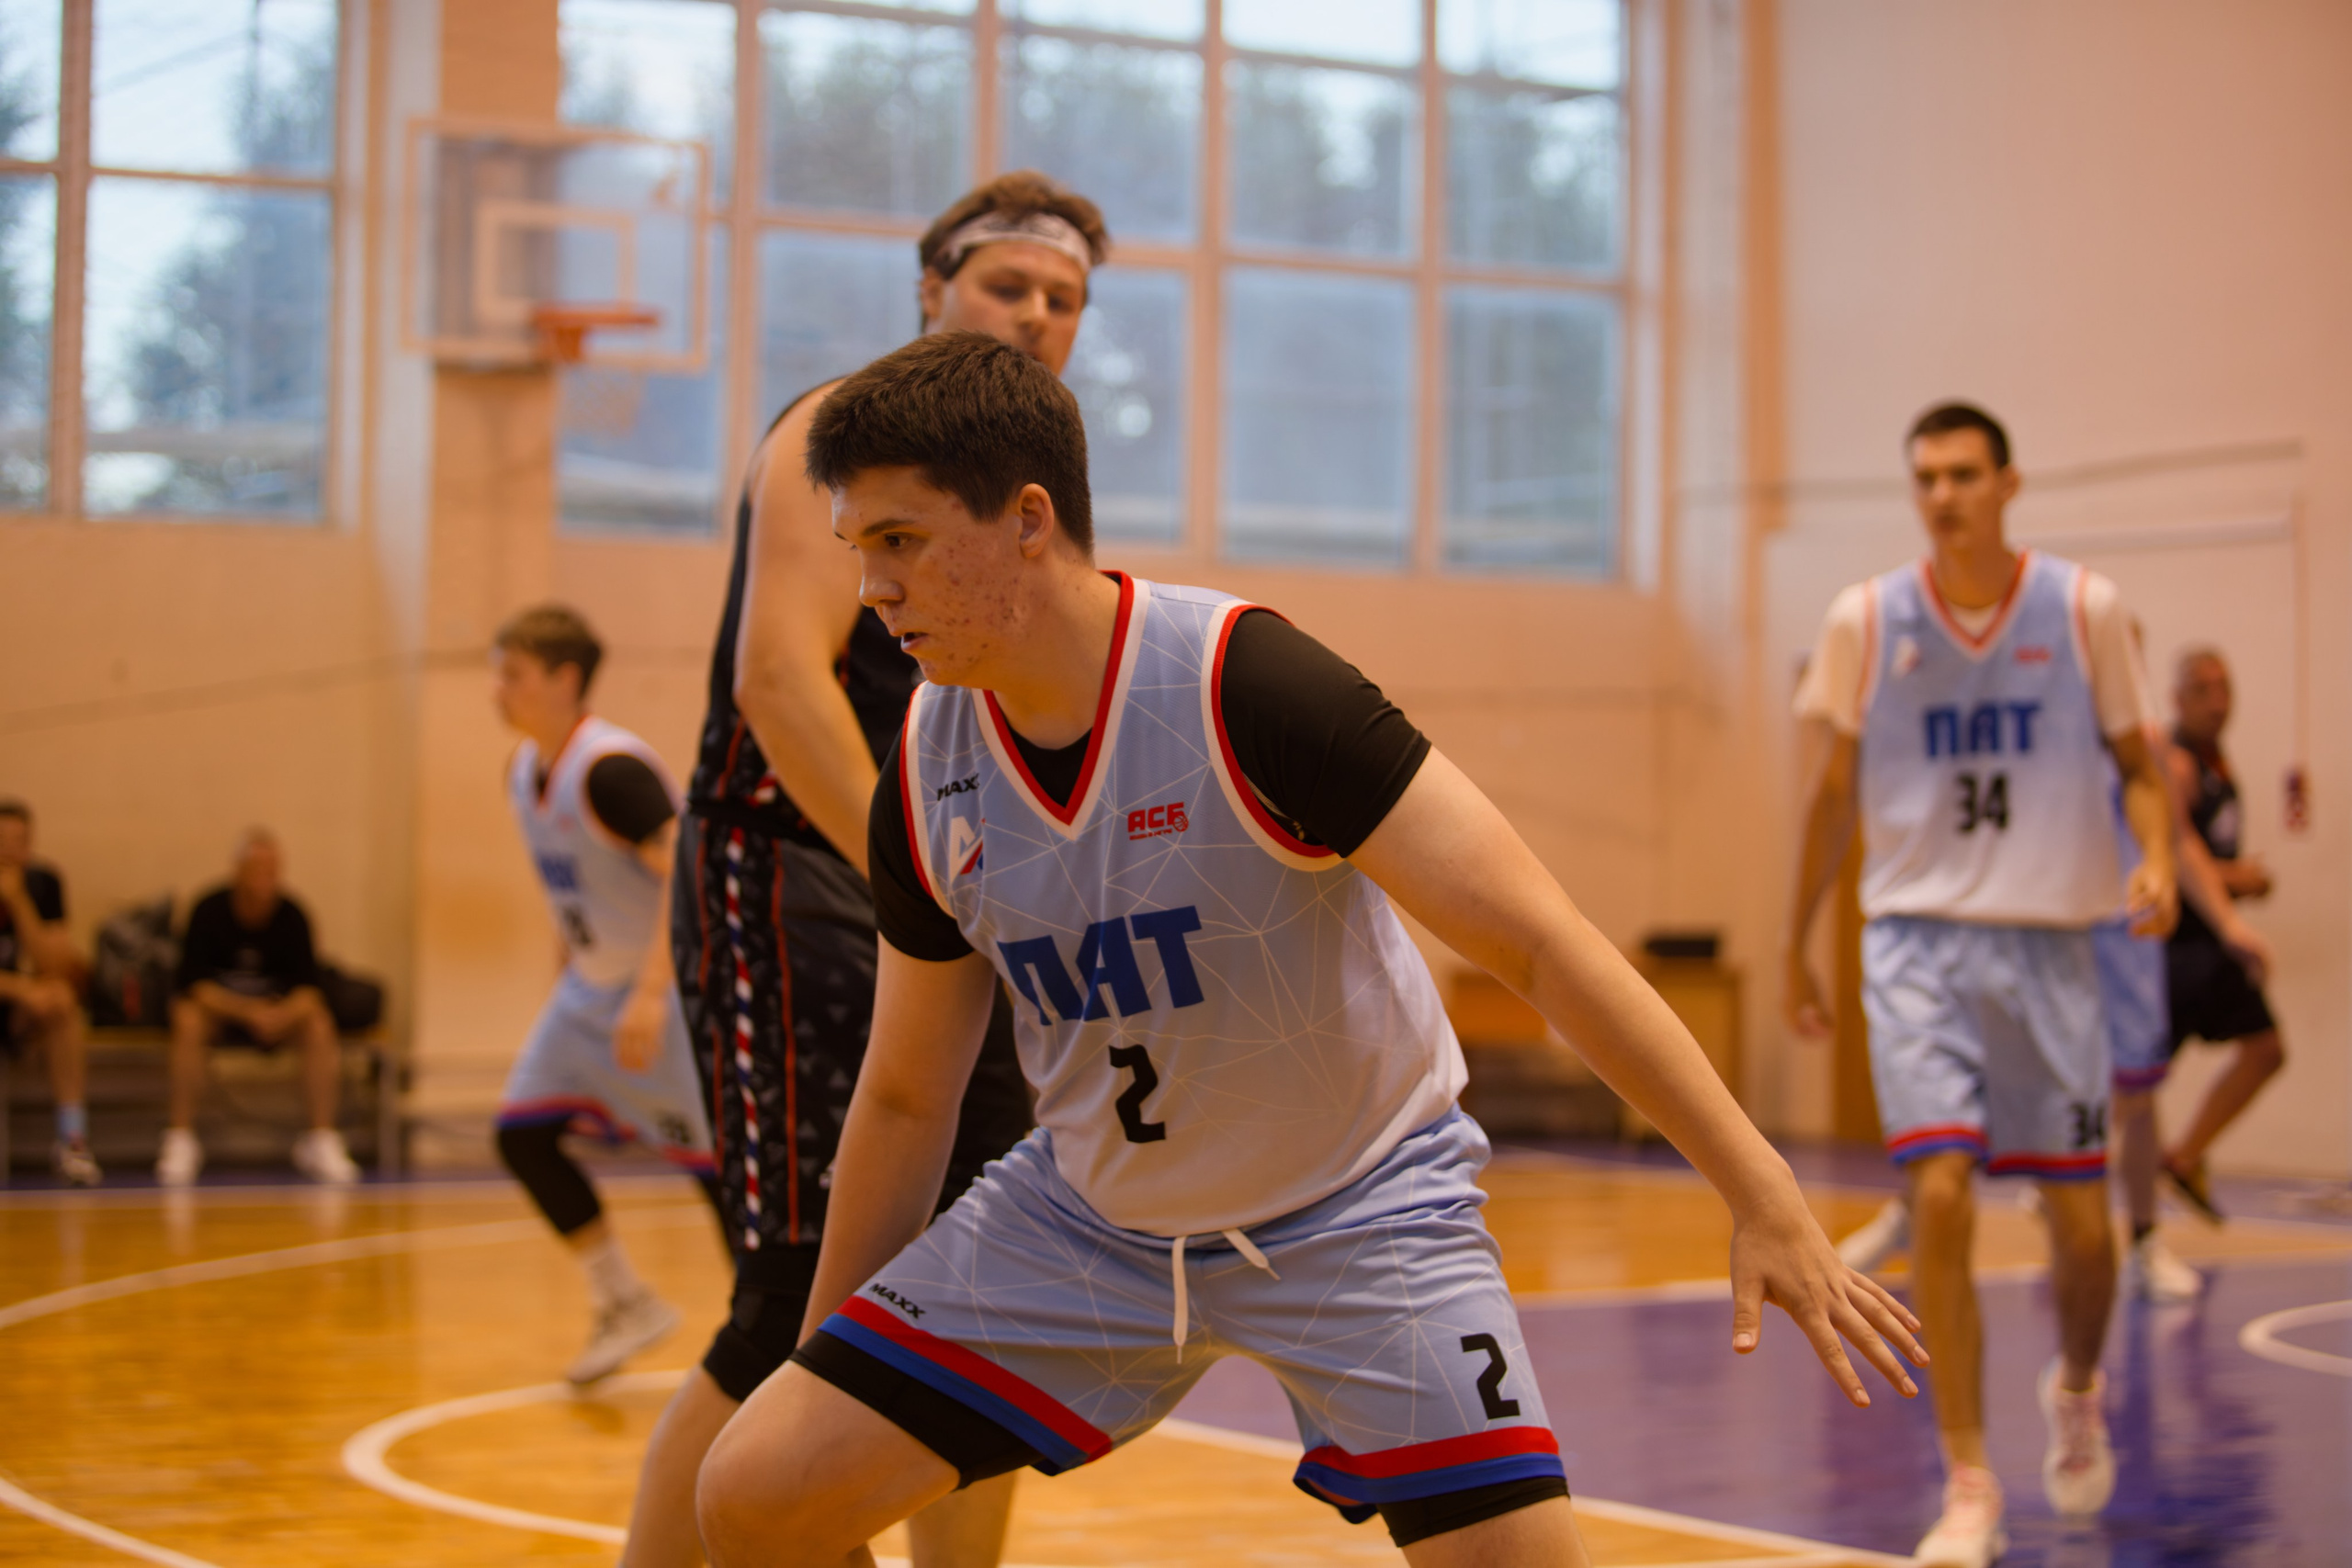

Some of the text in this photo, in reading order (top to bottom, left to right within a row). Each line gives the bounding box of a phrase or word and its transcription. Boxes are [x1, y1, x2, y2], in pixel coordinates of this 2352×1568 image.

[1924, 702, 2040, 760] ПАТ
[1956, 773, 2009, 833] 34
[997, 905, 1205, 1026] ПАТ
[1108, 1043, 1166, 1144] 2
[869, 1282, 926, 1319] MAXX
[1460, 1332, 1521, 1420] 2
